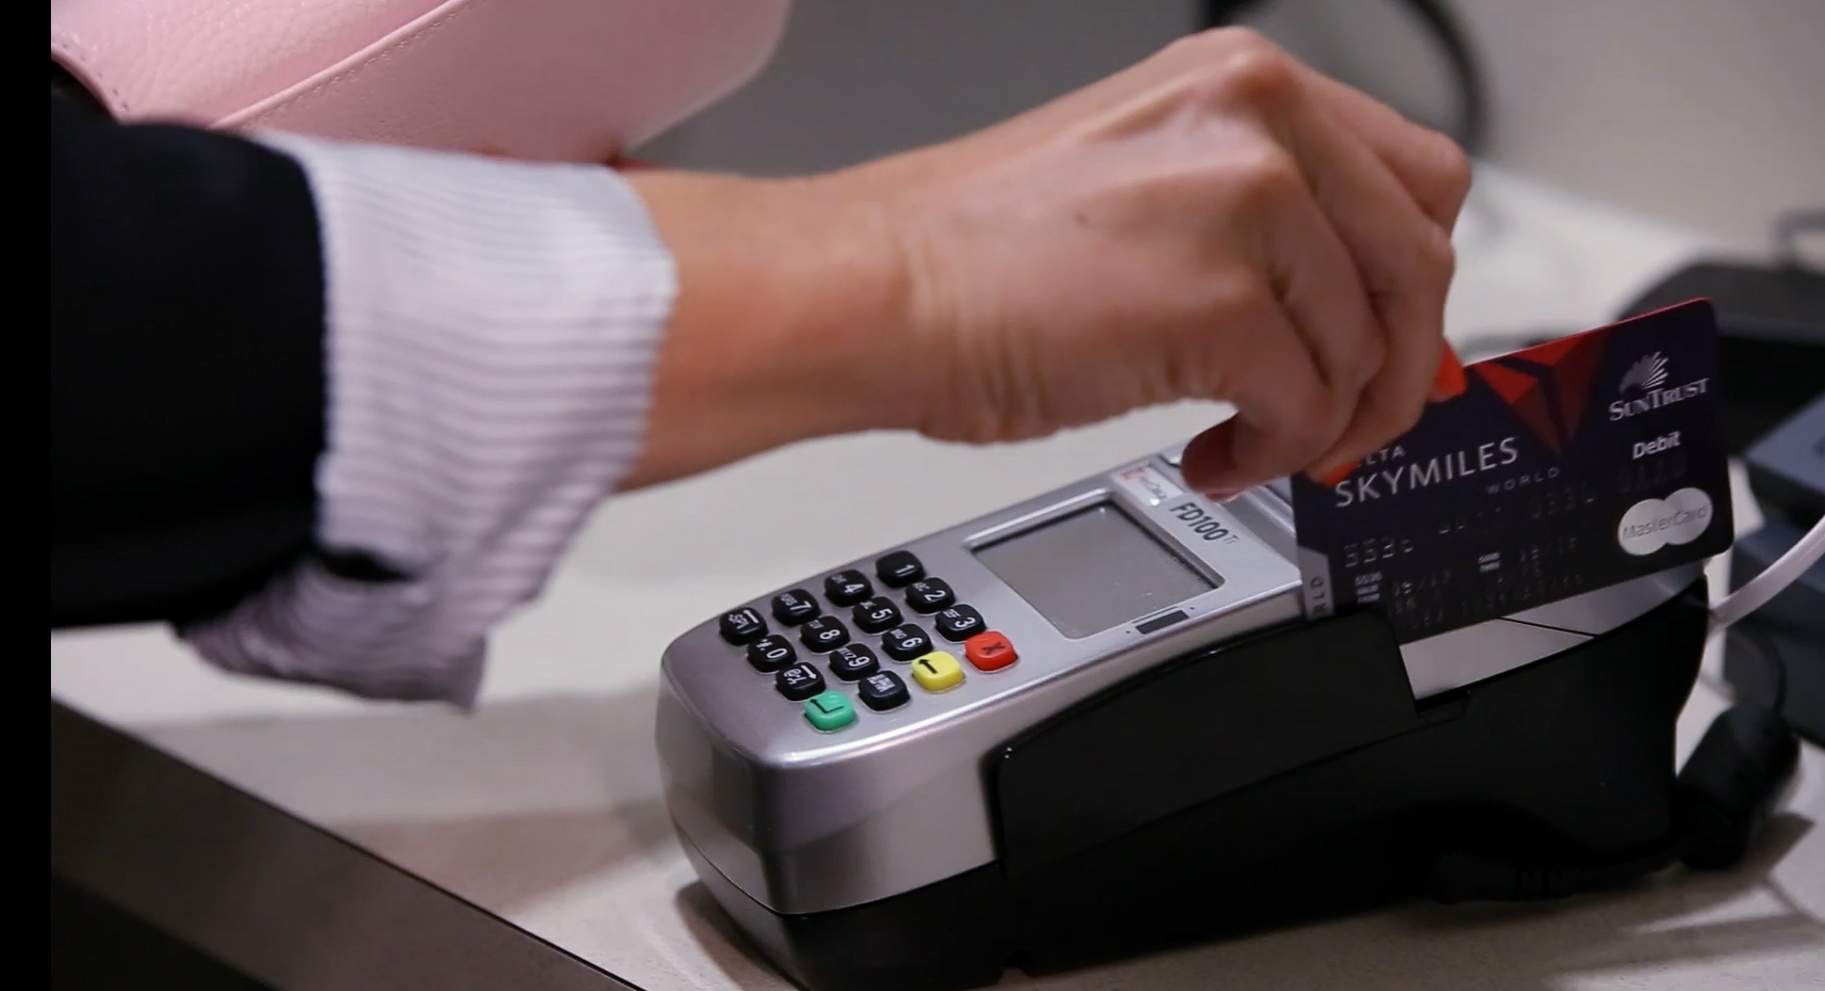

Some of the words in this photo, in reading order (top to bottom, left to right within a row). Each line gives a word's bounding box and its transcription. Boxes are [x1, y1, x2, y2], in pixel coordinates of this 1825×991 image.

[1632, 430, 1681, 460] Debit
[1357, 444, 1406, 468] LTA
[1335, 437, 1518, 507] SKYMILES
[1486, 466, 1561, 495] WORLD
[1169, 502, 1229, 541] FD100
[1621, 503, 1709, 540] MasterCard
[844, 583, 864, 593] 4
[924, 590, 946, 601] 2
[1311, 577, 1326, 613] RLD
[790, 600, 812, 611] 7
[871, 608, 893, 619] 5
[955, 617, 976, 628] 3
[819, 629, 841, 640] 8
[902, 637, 923, 648] 6
[766, 648, 788, 659] 0
[848, 656, 870, 667] 9
